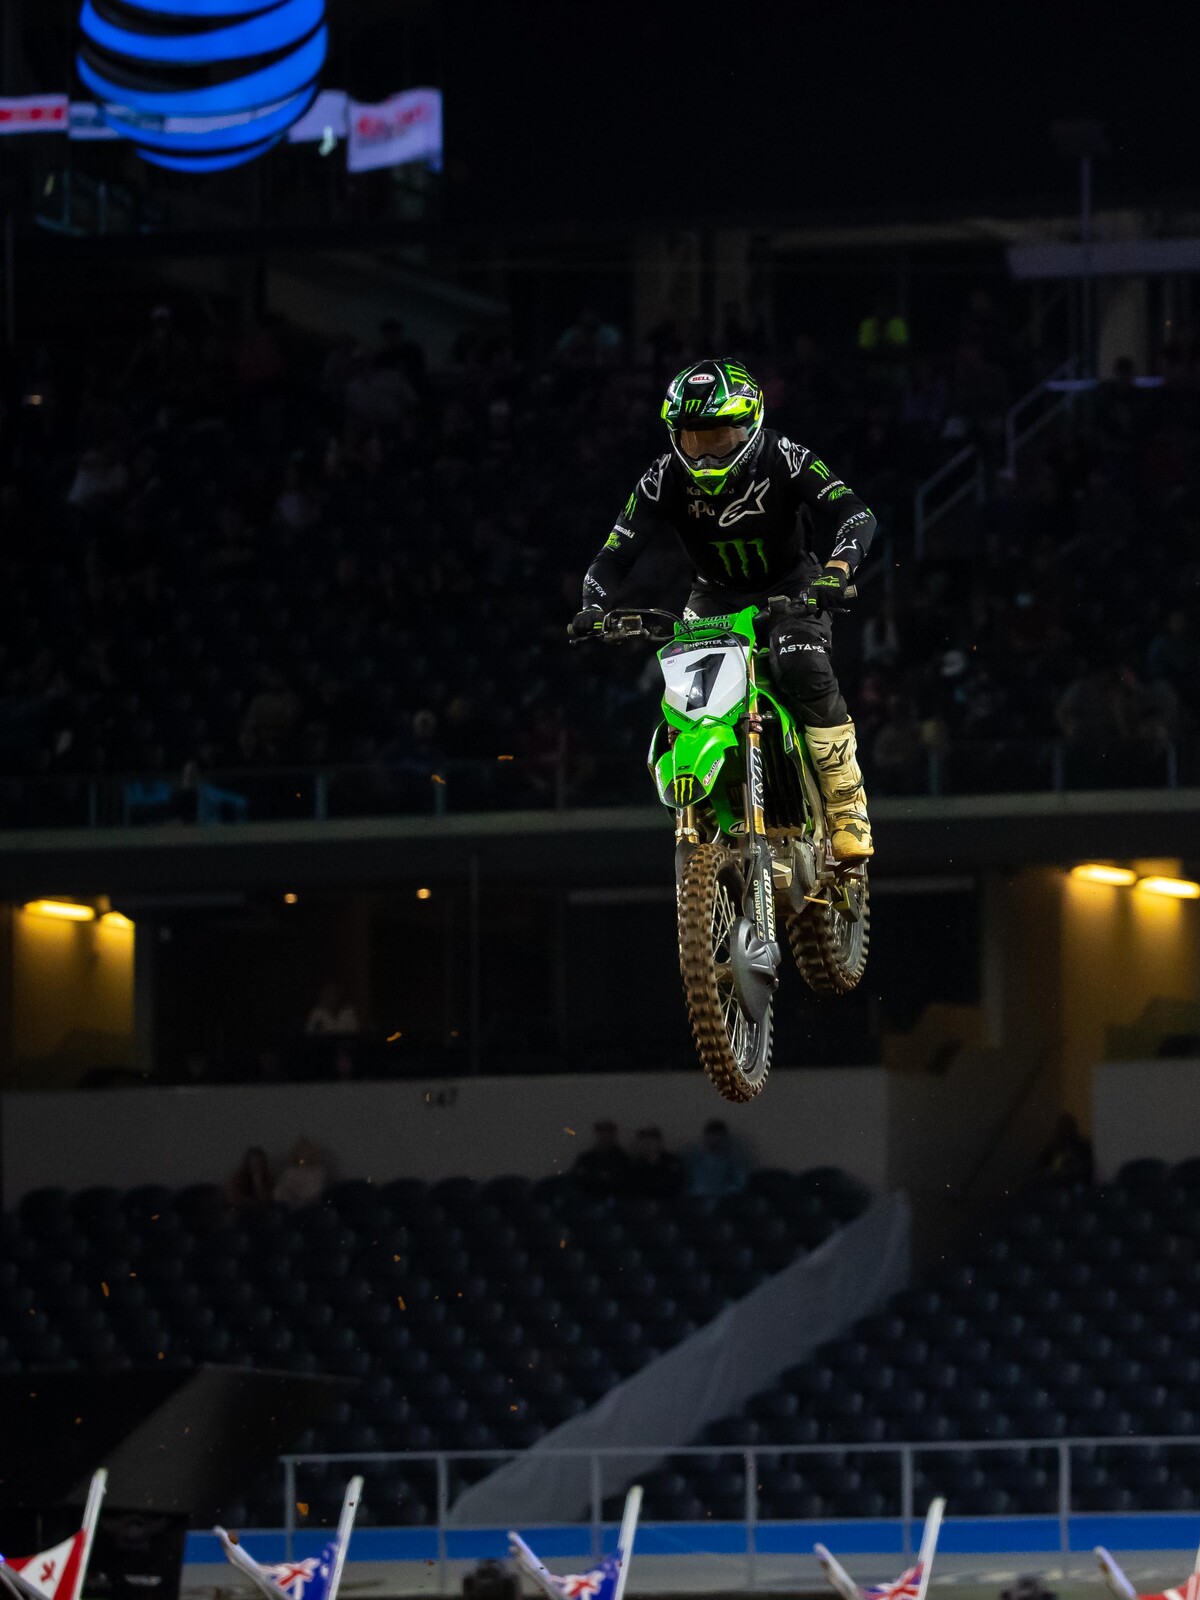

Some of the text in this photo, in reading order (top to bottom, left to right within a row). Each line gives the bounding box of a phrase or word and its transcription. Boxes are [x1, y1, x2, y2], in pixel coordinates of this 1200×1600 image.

[684, 653, 726, 713] 1
[753, 879, 762, 921] CARRILLO
[763, 868, 777, 942] DUNLOP
